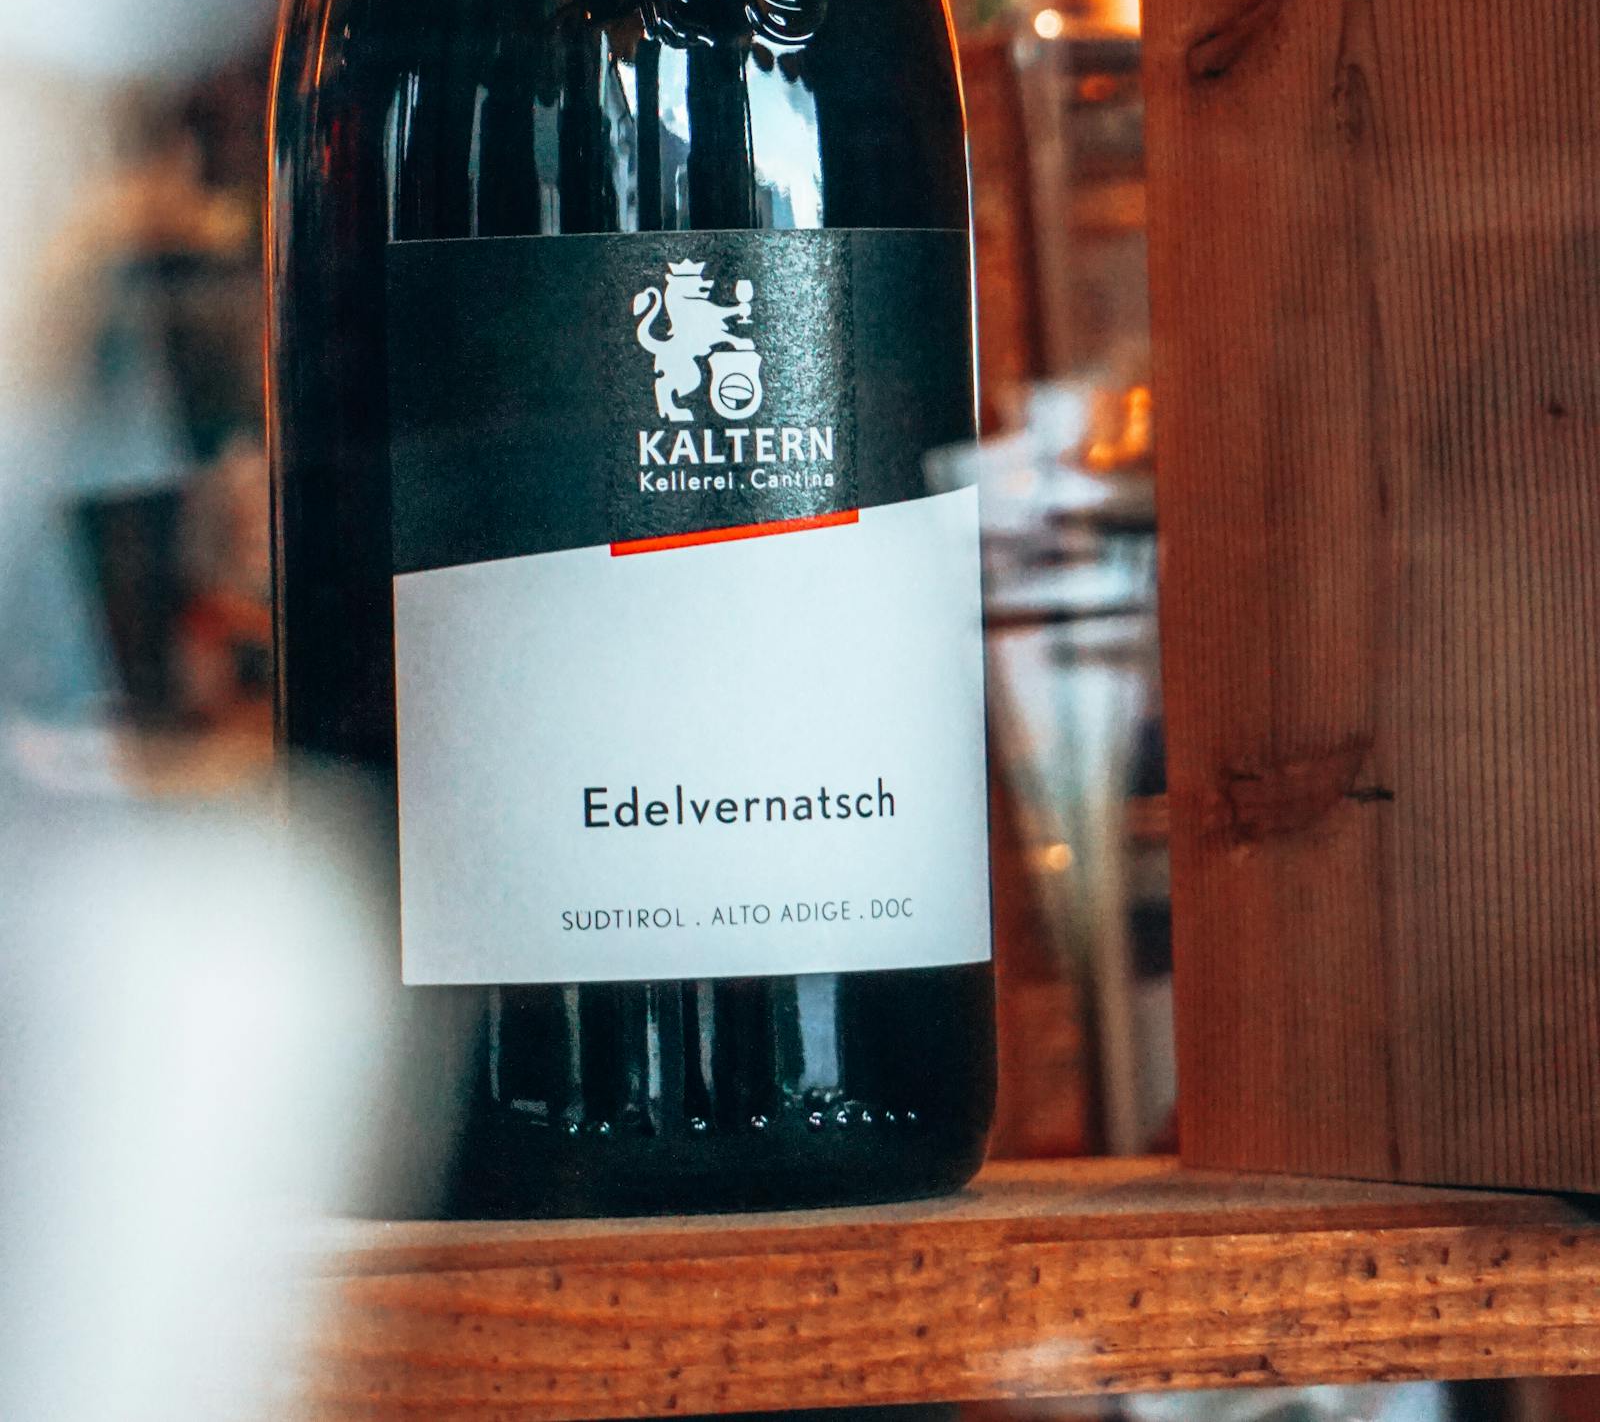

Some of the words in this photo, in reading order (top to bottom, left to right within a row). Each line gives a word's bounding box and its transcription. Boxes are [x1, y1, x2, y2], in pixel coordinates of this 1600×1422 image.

[638, 426, 835, 466] KALTERN
[639, 470, 734, 492] Kellerei
[750, 467, 835, 490] Cantina
[583, 777, 896, 828] Edelvernatsch
[561, 907, 686, 931] SÜDTIROL
[711, 904, 771, 926] ALTO
[780, 900, 851, 923] ADIGE
[871, 897, 913, 919] DOC
